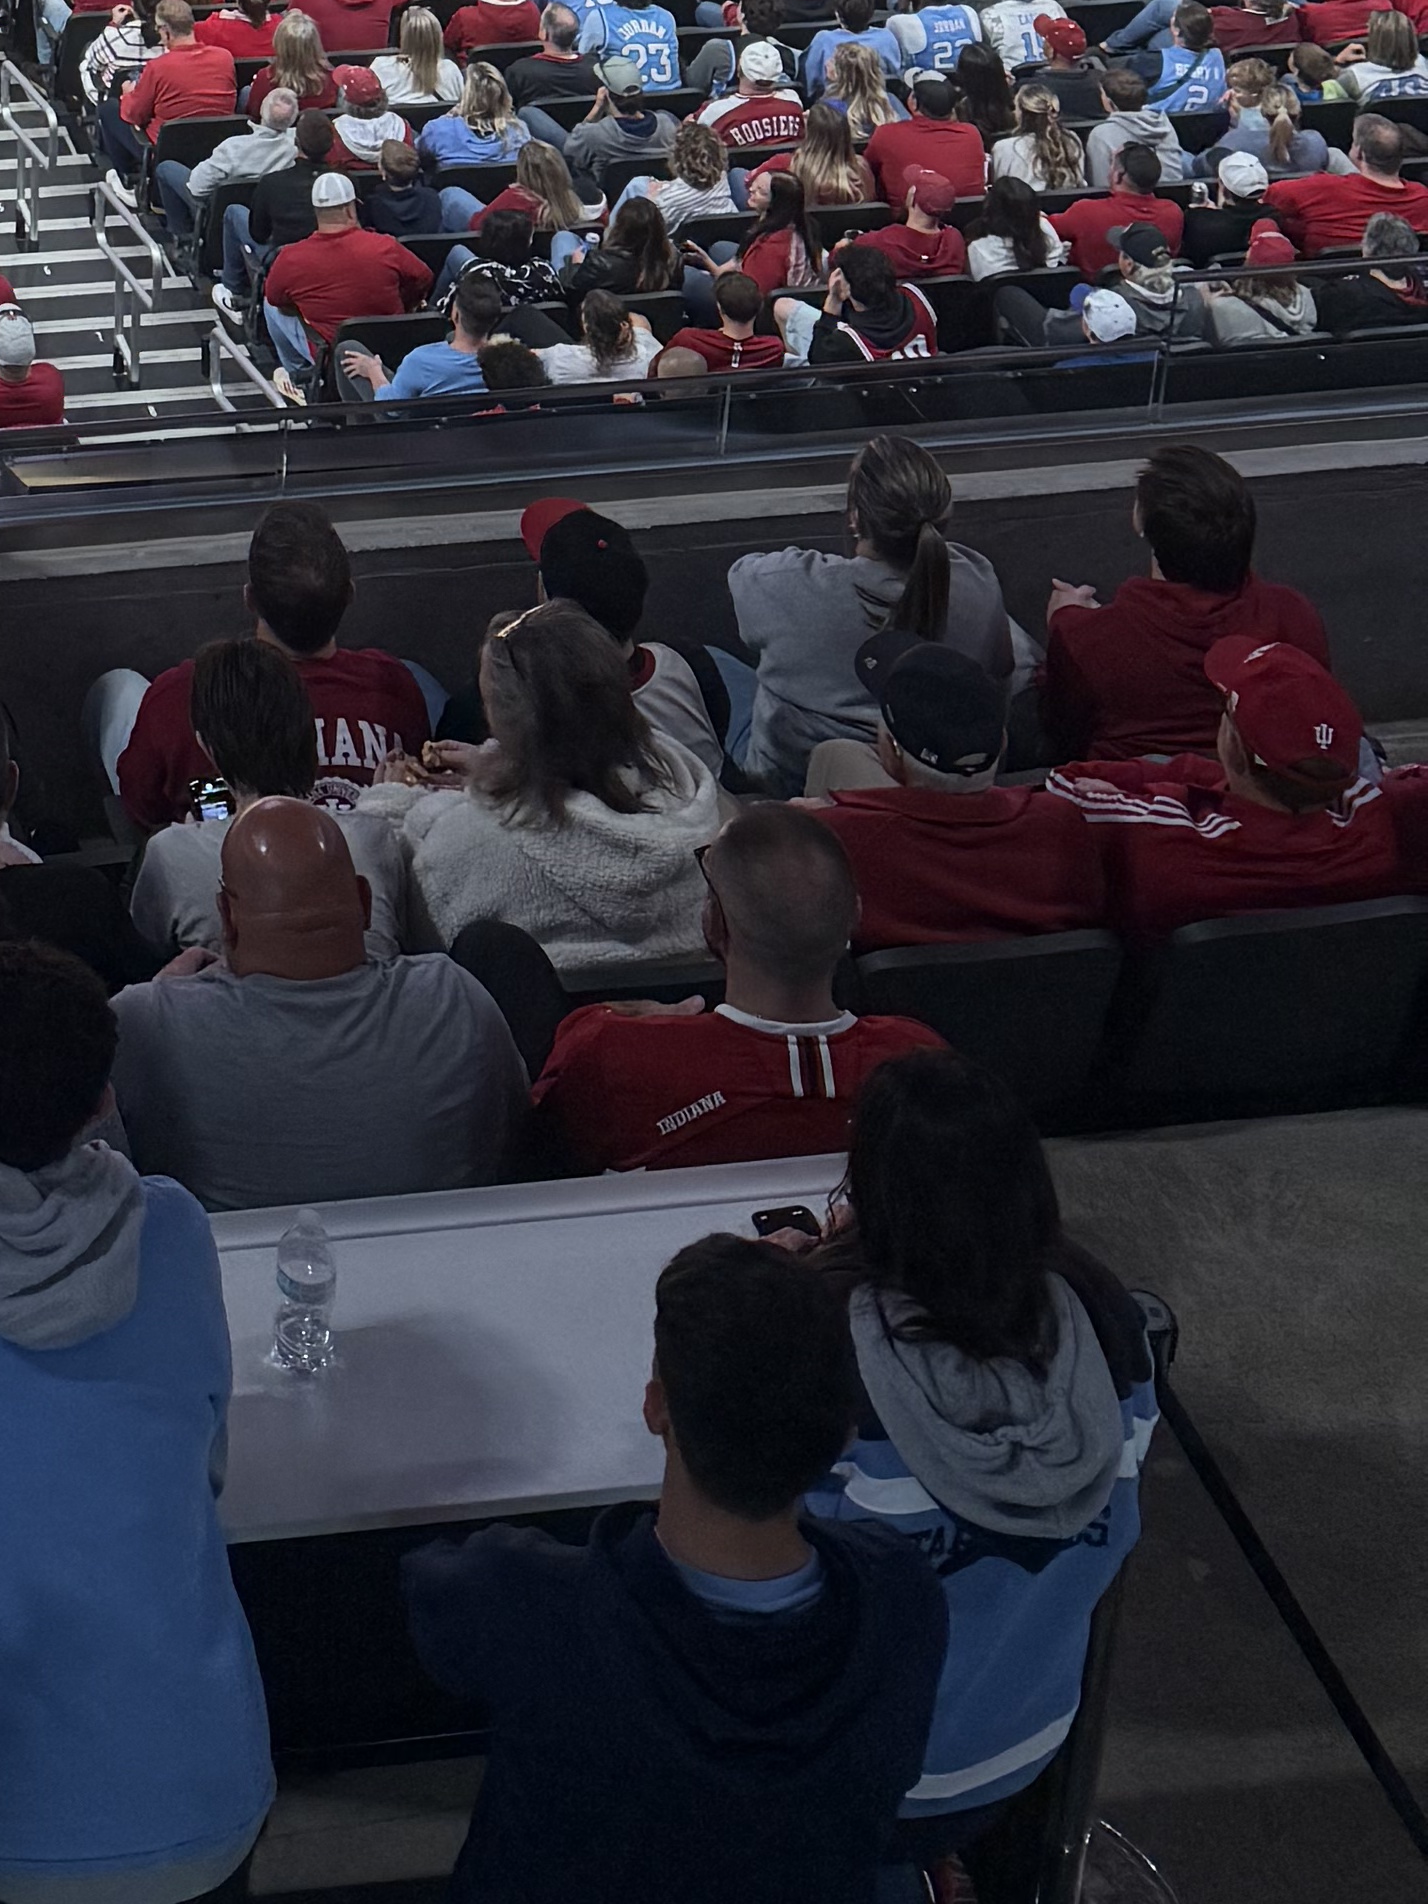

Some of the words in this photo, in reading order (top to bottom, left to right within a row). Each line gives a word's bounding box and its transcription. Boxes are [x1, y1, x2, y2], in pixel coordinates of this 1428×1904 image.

[617, 17, 667, 41] JORDAN
[621, 43, 672, 84] 23
[1183, 84, 1209, 113] 2
[730, 115, 802, 146] HOOSIERS
[656, 1090, 727, 1136] INDIANA
